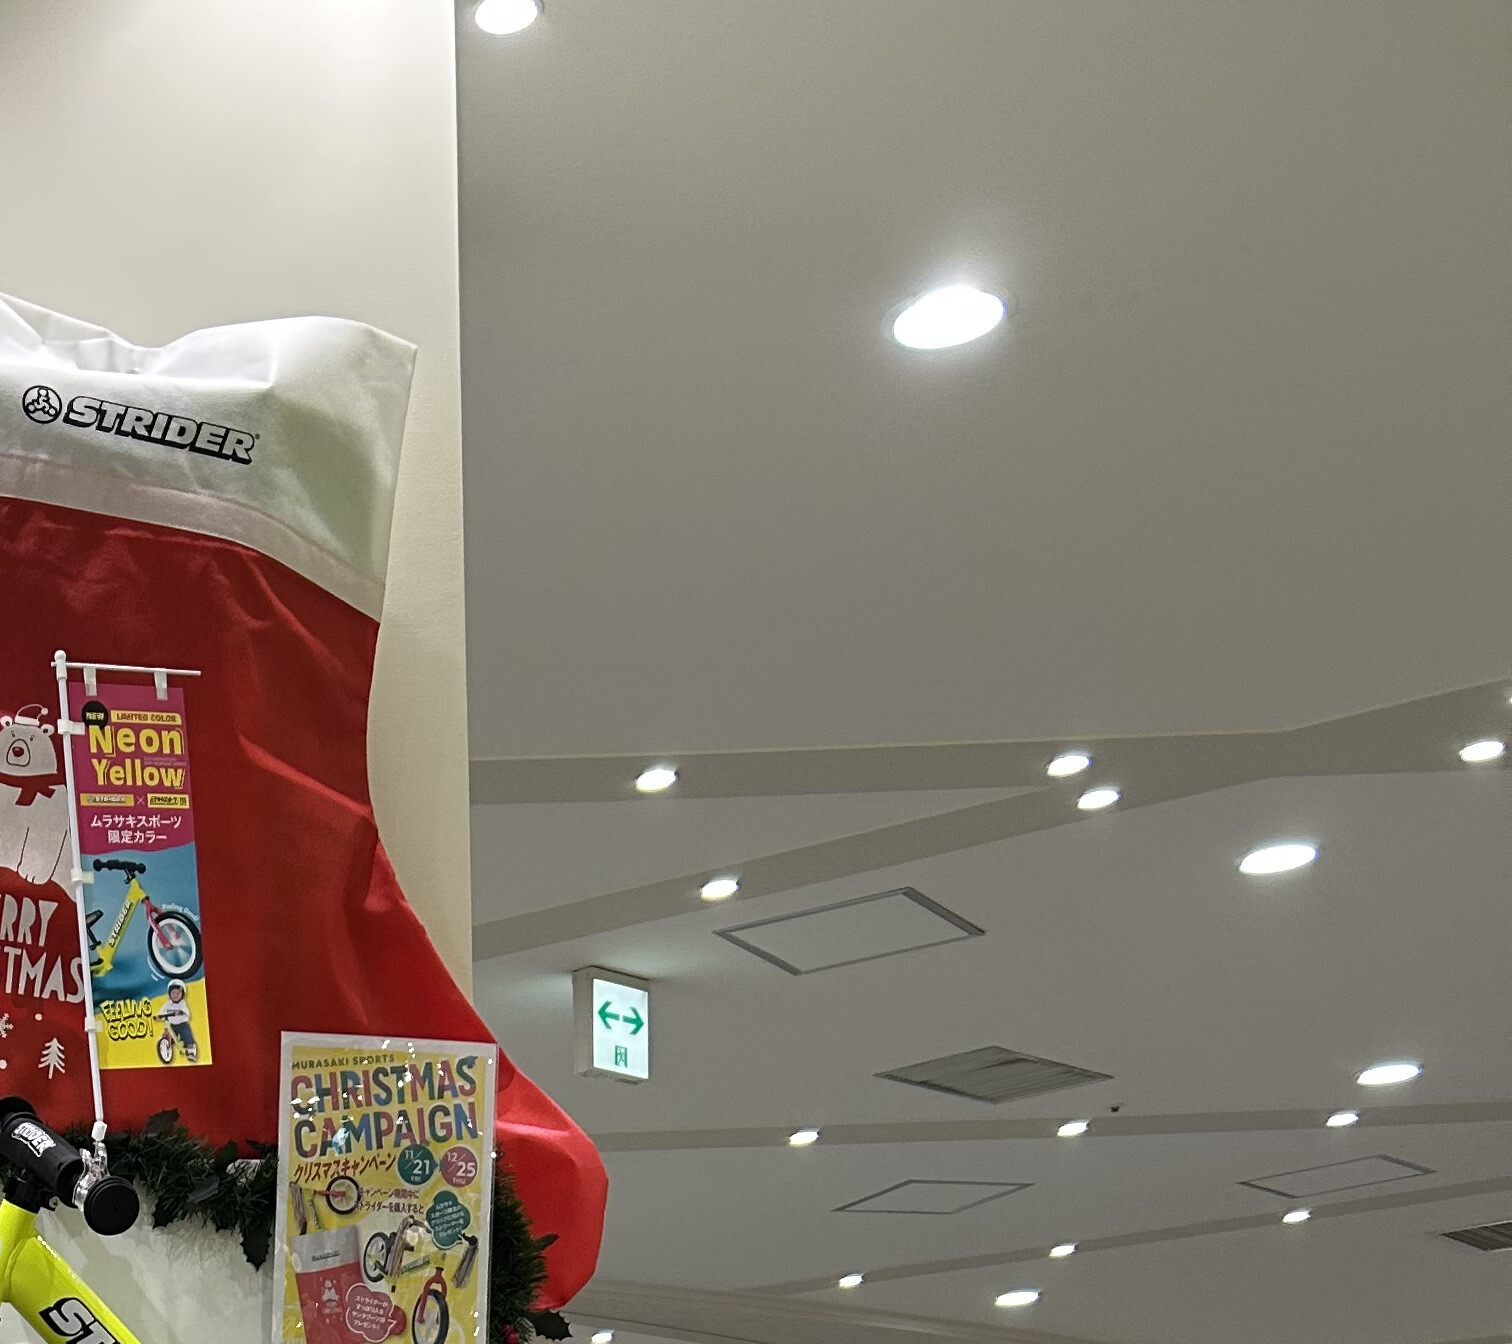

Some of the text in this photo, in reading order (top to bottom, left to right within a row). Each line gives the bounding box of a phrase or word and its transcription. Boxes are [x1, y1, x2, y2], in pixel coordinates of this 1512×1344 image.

[63, 396, 255, 465] STRIDER
[88, 725, 185, 756] Neon
[91, 758, 185, 789] Yellow
[90, 814, 182, 829] ムラサキスポーツ
[107, 830, 168, 844] 限定カラー
[108, 899, 134, 949] STRIDER
[99, 996, 153, 1024] FEELING
[292, 1054, 395, 1069] MURASAKI SPORTS
[290, 1056, 478, 1115] CHRISTMAS
[293, 1101, 478, 1159] CAMPAIGN
[293, 1153, 397, 1184] クリスマスキャンペーン
